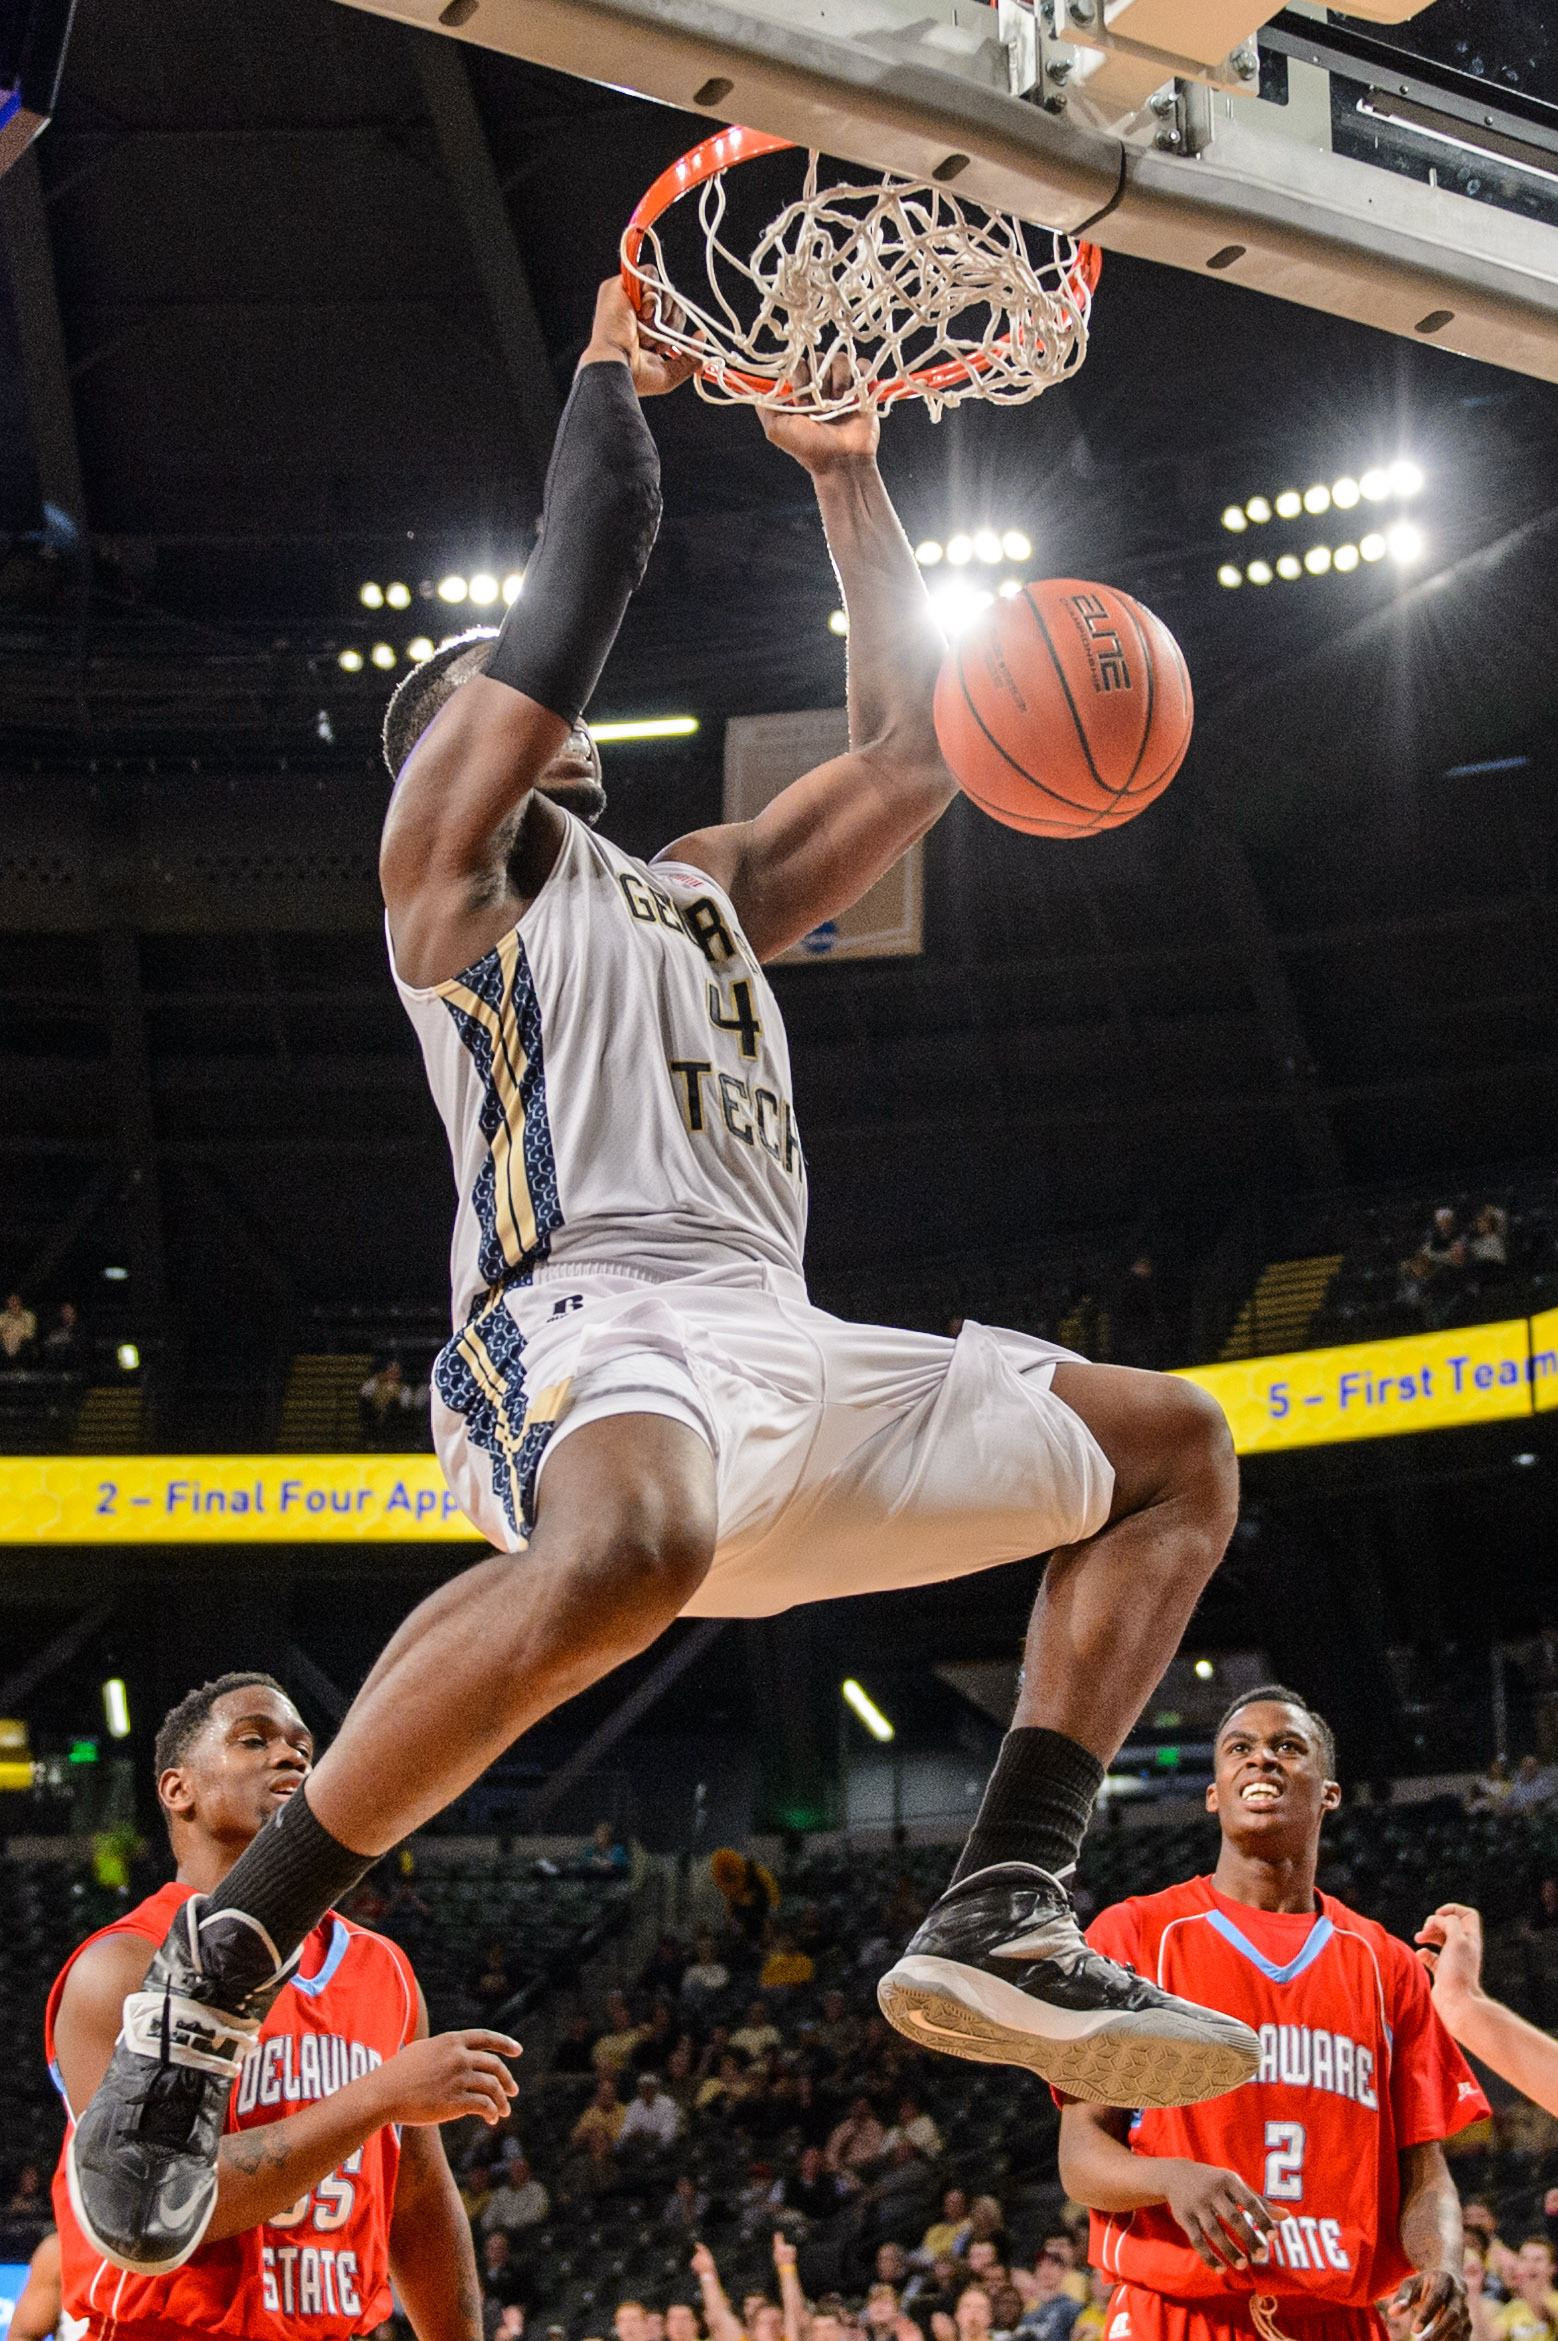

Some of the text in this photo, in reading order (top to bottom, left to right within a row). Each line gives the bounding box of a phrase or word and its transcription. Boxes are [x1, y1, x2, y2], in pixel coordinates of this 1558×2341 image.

[705, 977, 763, 1061] 4
[671, 1060, 804, 1186] TECH
[1268, 1382, 1290, 1419] 5
[1339, 1366, 1433, 1410] First
[1446, 1350, 1558, 1394] Team
[95, 1482, 119, 1515] 2
[165, 1481, 263, 1514] Final
[280, 1481, 373, 1514] Four
[1246, 2022, 1378, 2112] AWARE
[1263, 2120, 1307, 2201] 2
[262, 2246, 362, 2316] STATE
